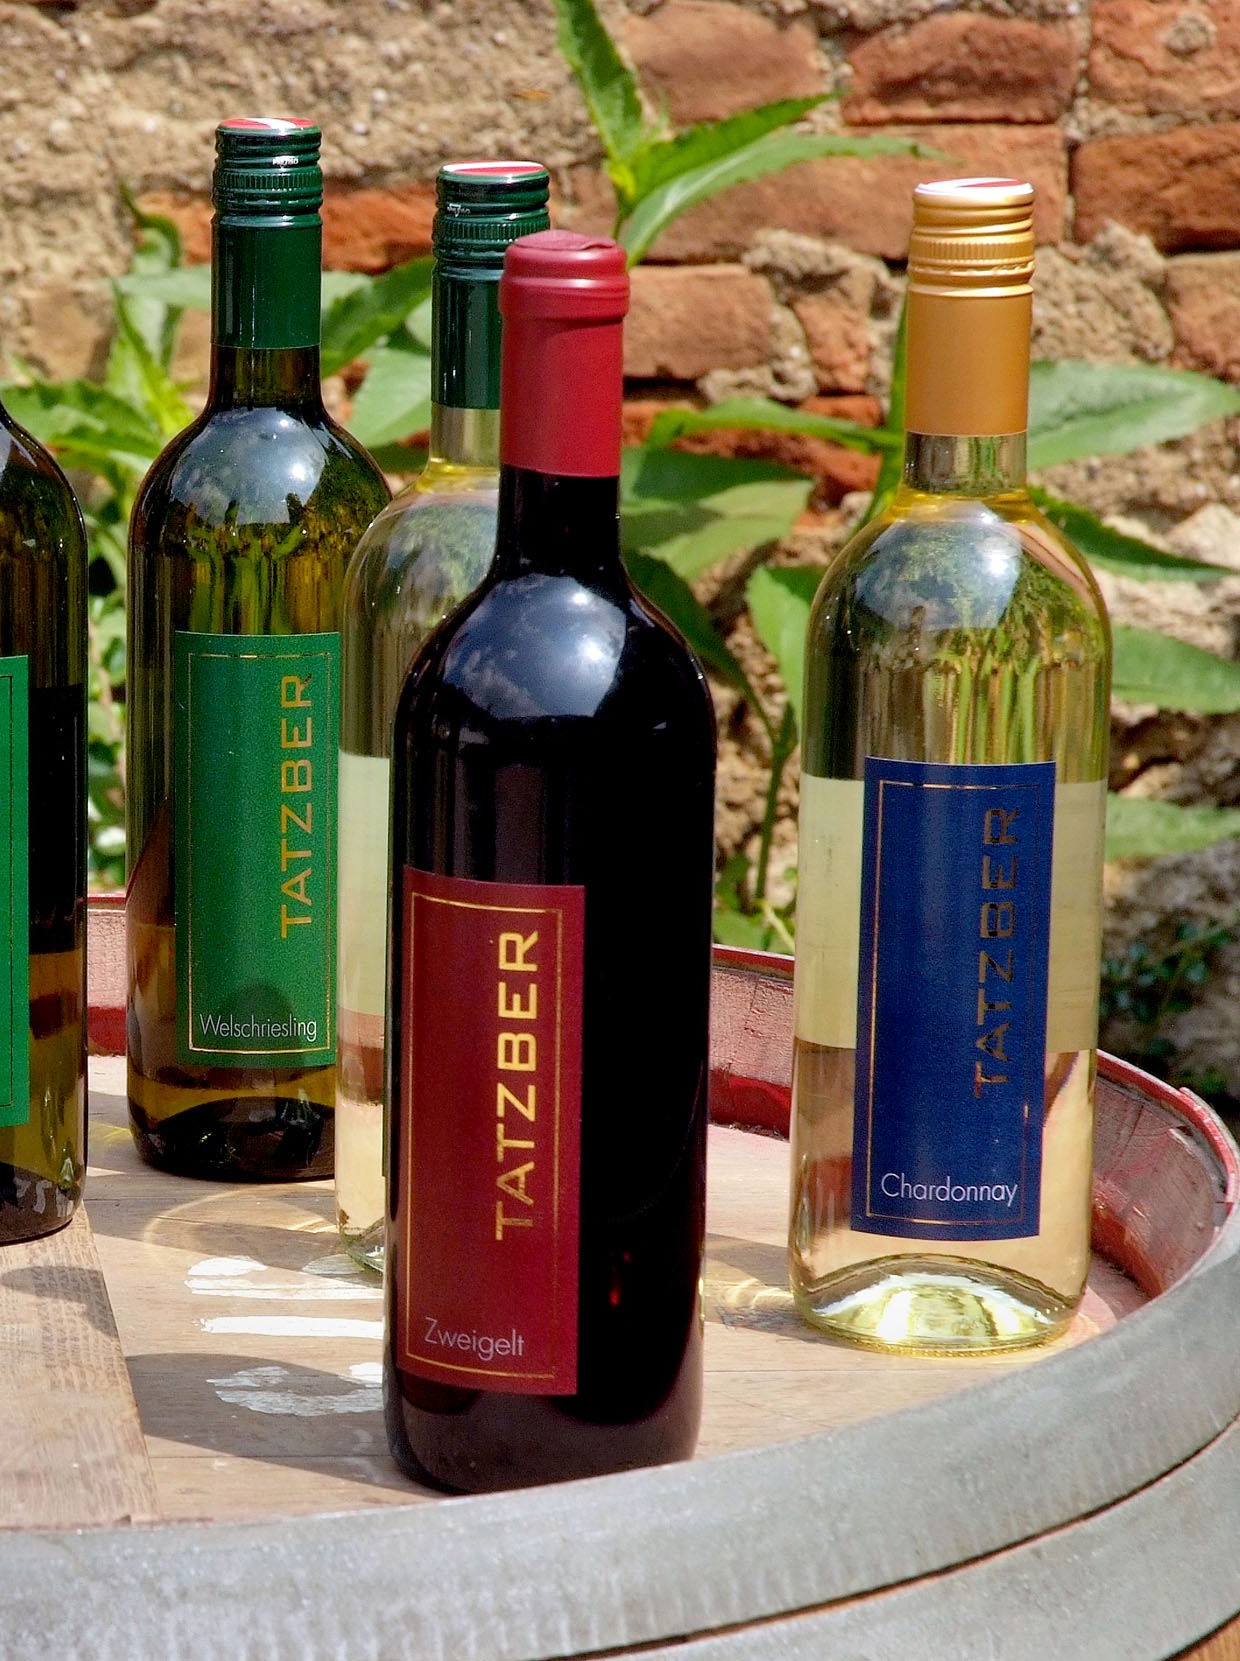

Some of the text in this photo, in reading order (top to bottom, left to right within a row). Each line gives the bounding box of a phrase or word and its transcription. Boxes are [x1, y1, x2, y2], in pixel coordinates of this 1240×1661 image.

[280, 673, 313, 939] TATZBER
[199, 1013, 318, 1042] Welschriesling
[973, 806, 1021, 1100] TATZBER
[495, 929, 540, 1241] TATZBER
[880, 1172, 1019, 1206] Chardonnay
[424, 1317, 525, 1361] Zweigelt
